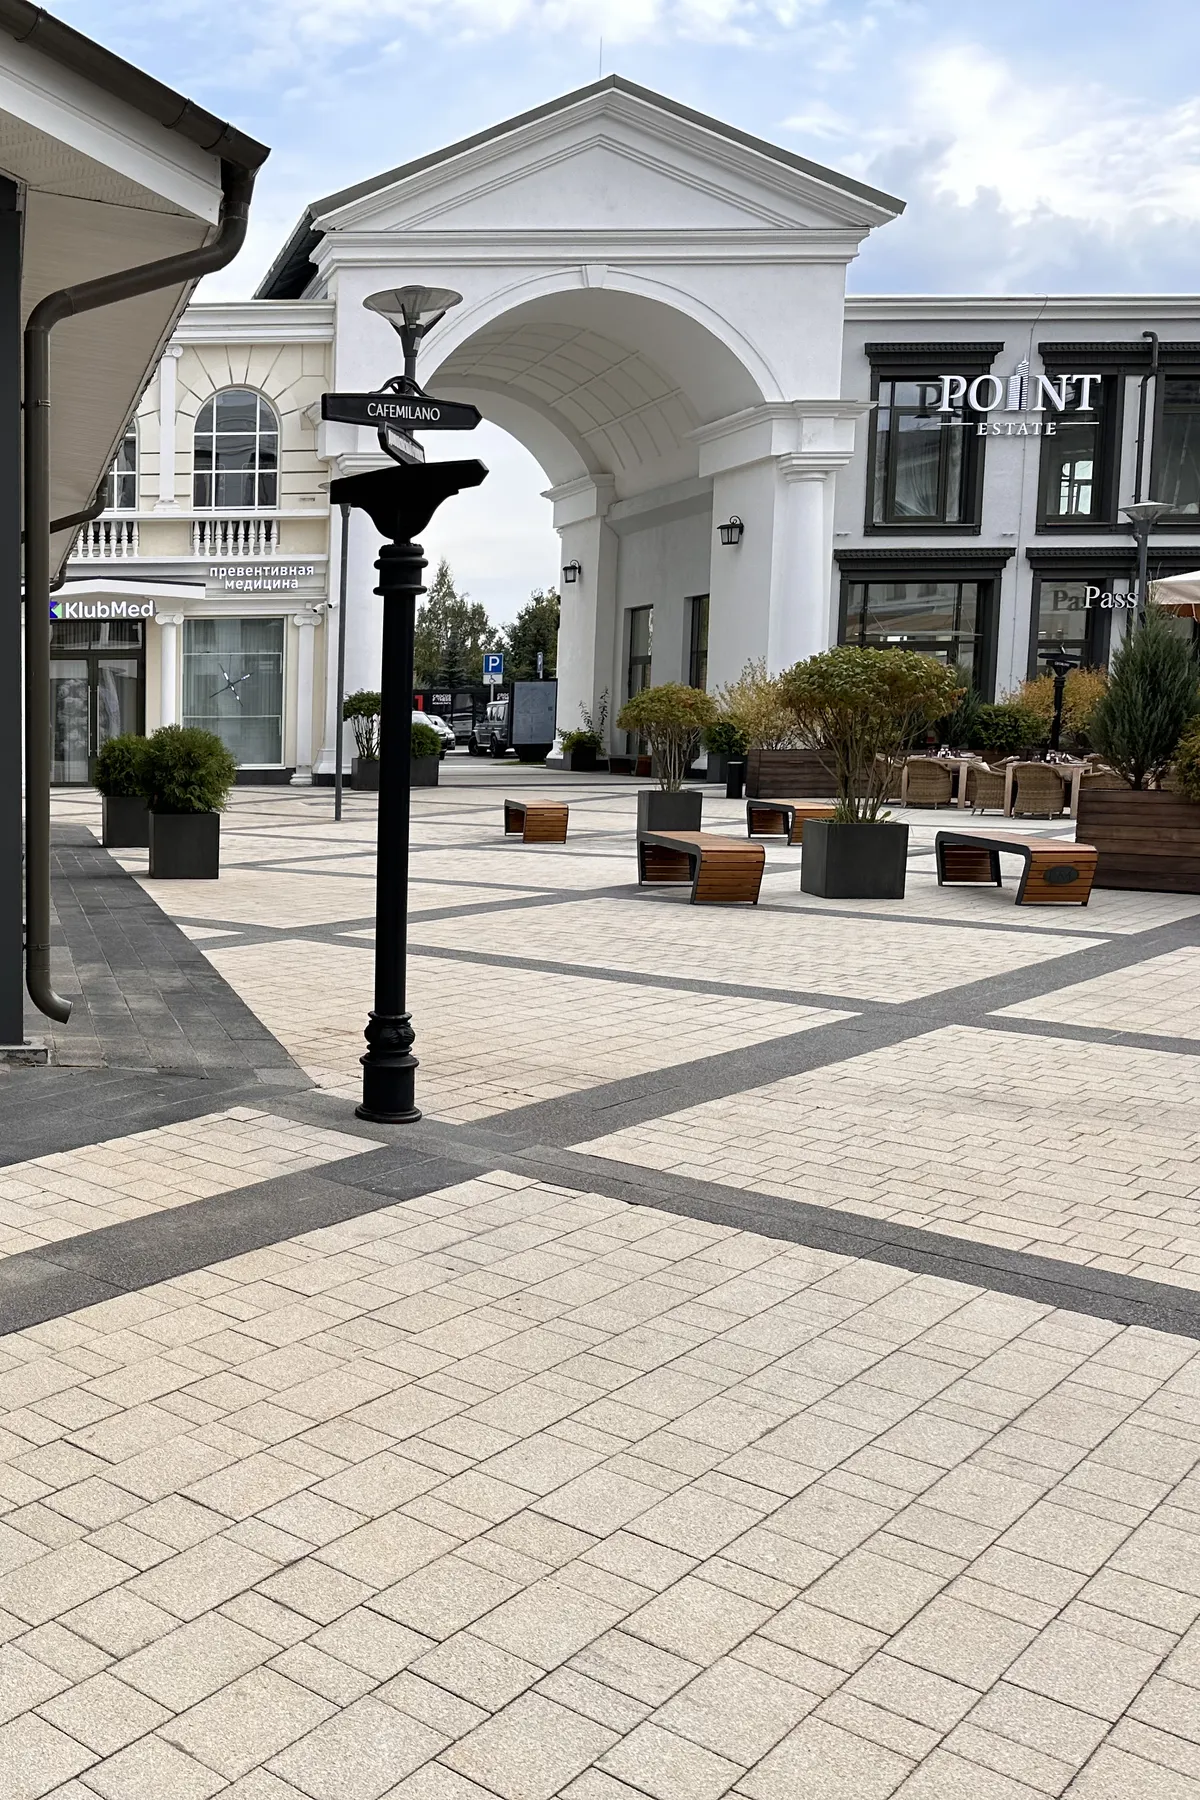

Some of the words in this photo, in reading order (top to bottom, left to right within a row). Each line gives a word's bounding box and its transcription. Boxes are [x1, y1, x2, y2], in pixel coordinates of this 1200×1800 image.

[936, 364, 1101, 412] POINT
[367, 403, 440, 421] CAFEMILANO
[976, 422, 1057, 436] ESTATE
[209, 565, 315, 580] превентивная
[225, 578, 299, 591] медицина
[65, 600, 154, 618] KlubMed
[489, 656, 500, 671] P
